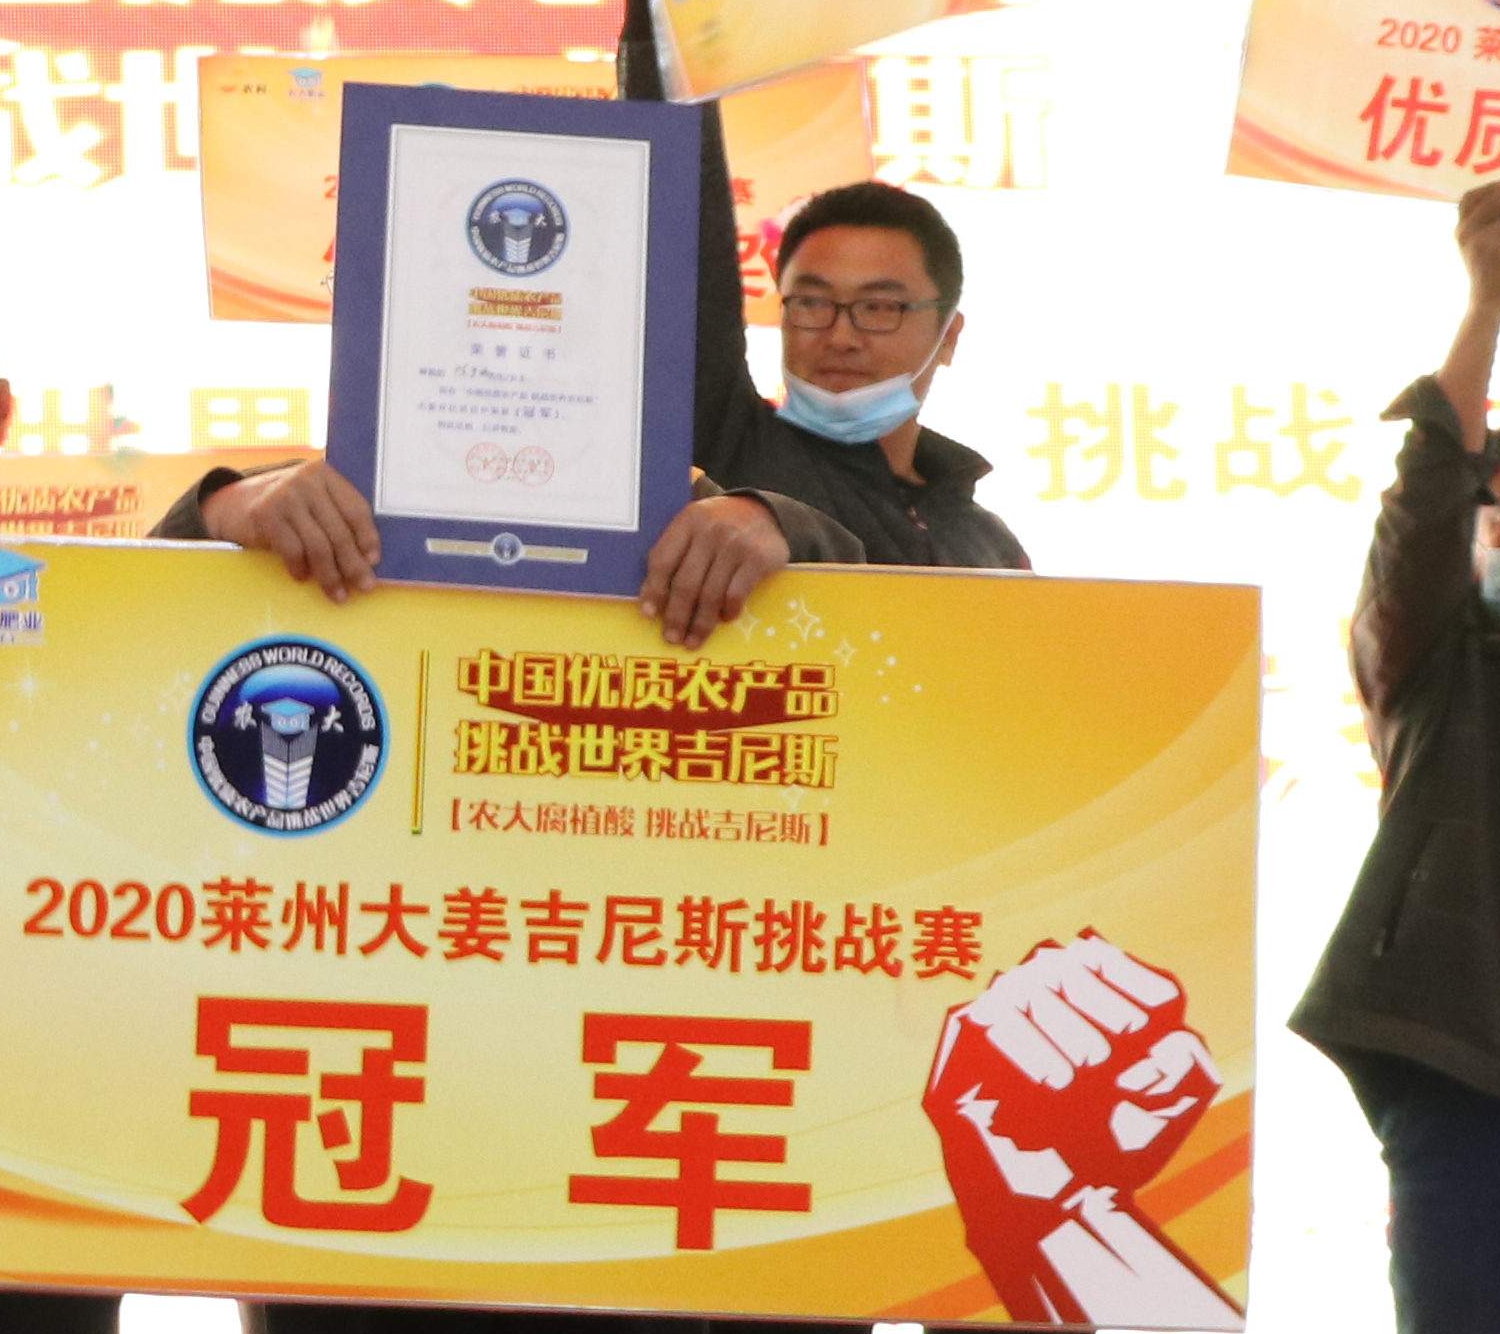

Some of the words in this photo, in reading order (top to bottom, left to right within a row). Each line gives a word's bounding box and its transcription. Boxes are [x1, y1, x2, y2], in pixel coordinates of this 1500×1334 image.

[1377, 18, 1461, 55] 2020
[262, 646, 325, 667] WORLD
[457, 648, 840, 718] 中国优质农产品
[453, 718, 839, 789] 挑战世界吉尼斯
[450, 797, 635, 838] 【农大腐植酸
[646, 805, 829, 847] 挑战吉尼斯】
[22, 876, 986, 982] 2020莱州大姜吉尼斯挑战赛
